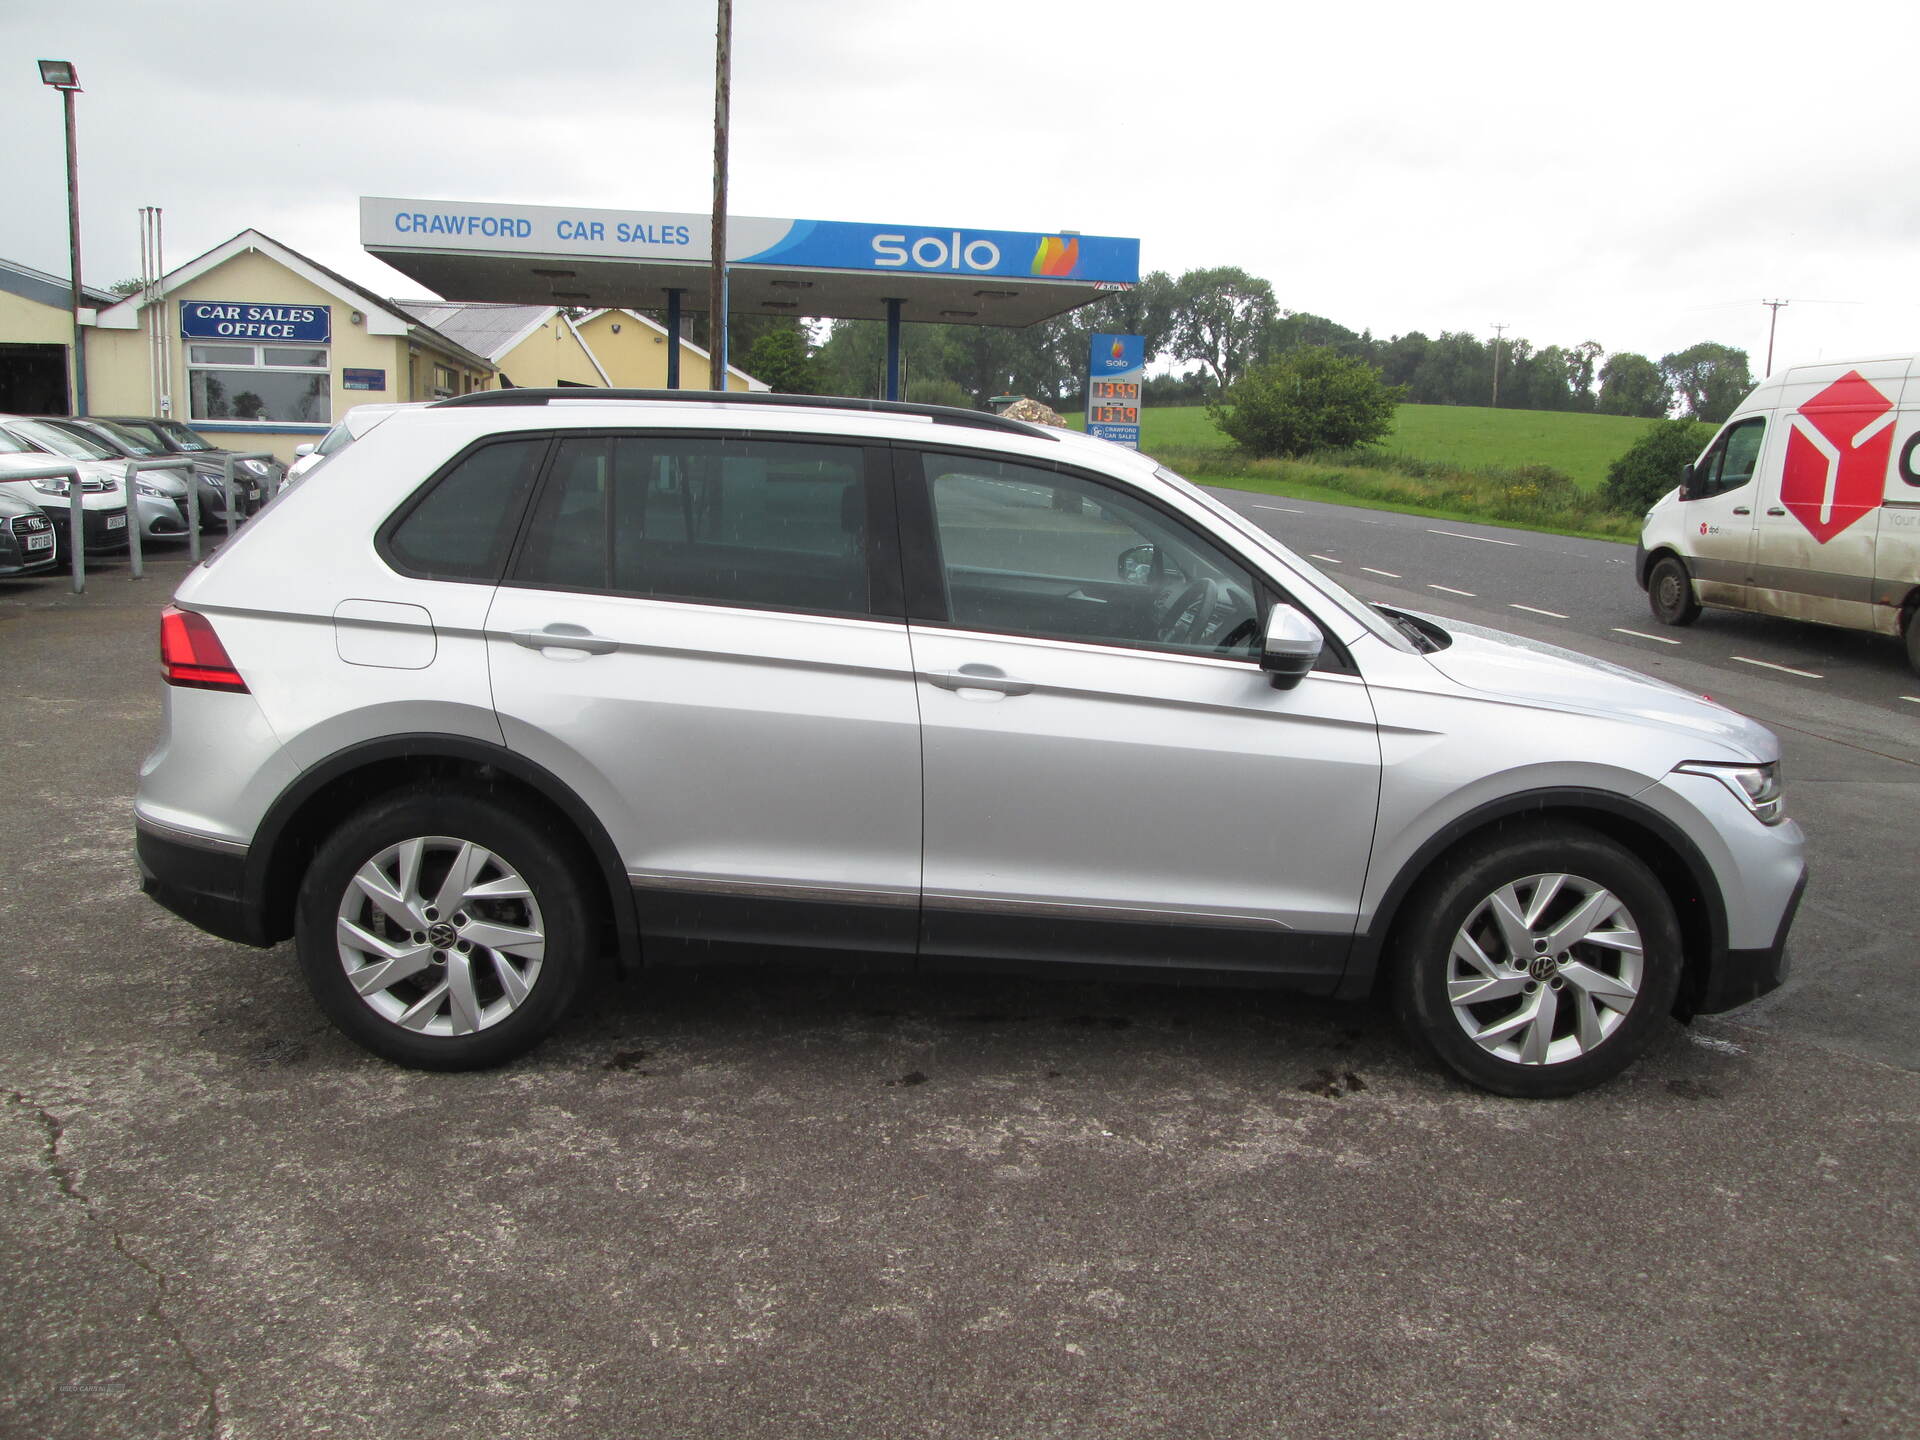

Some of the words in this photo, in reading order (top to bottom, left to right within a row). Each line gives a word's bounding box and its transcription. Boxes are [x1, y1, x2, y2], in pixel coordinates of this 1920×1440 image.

[395, 213, 532, 239] CRAWFORD
[556, 220, 605, 241] CAR
[616, 223, 690, 246] SALES
[872, 232, 1000, 270] solo
[196, 306, 241, 320] CAR
[247, 308, 315, 323] SALES
[217, 322, 296, 338] OFFICE
[1888, 513, 1916, 526] Your
